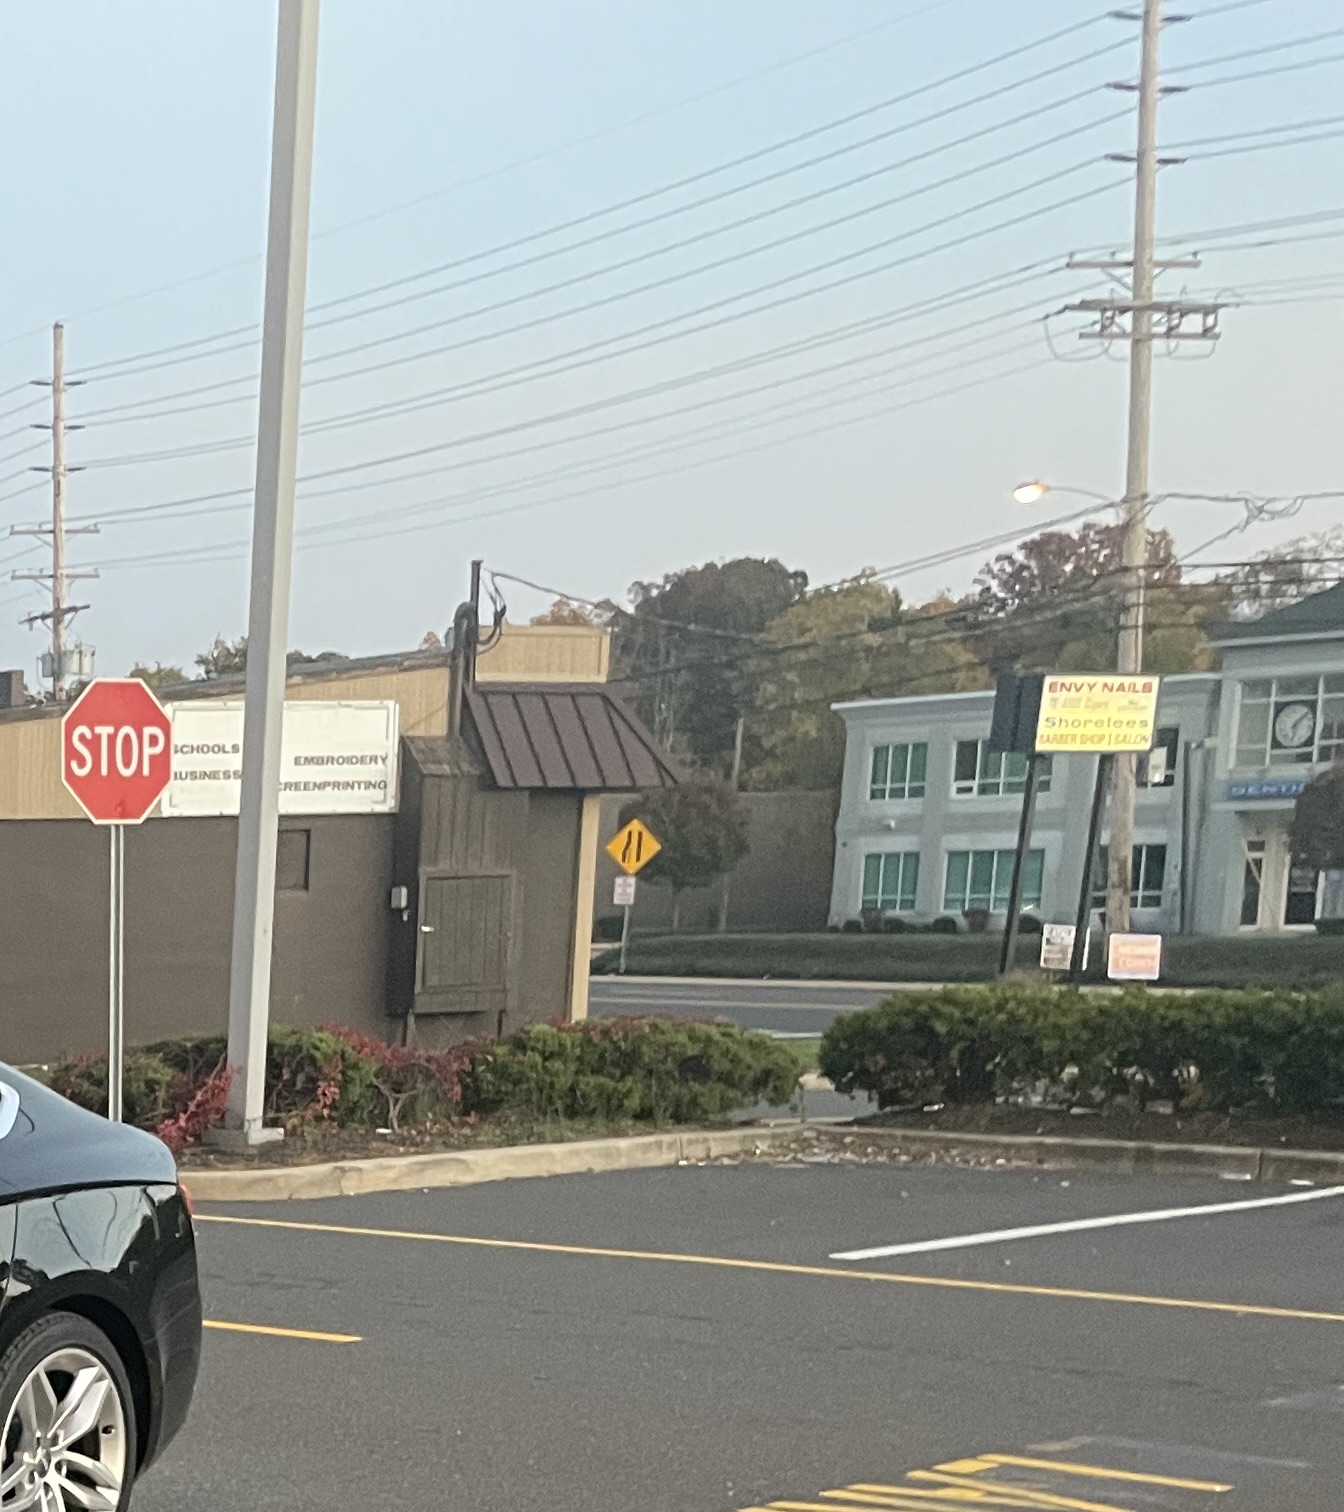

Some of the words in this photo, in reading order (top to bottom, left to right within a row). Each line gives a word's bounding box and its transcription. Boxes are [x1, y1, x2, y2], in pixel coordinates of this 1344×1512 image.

[1048, 681, 1096, 693] ENVY
[70, 725, 165, 777] STOP
[294, 754, 388, 766] EMBROIDERY
